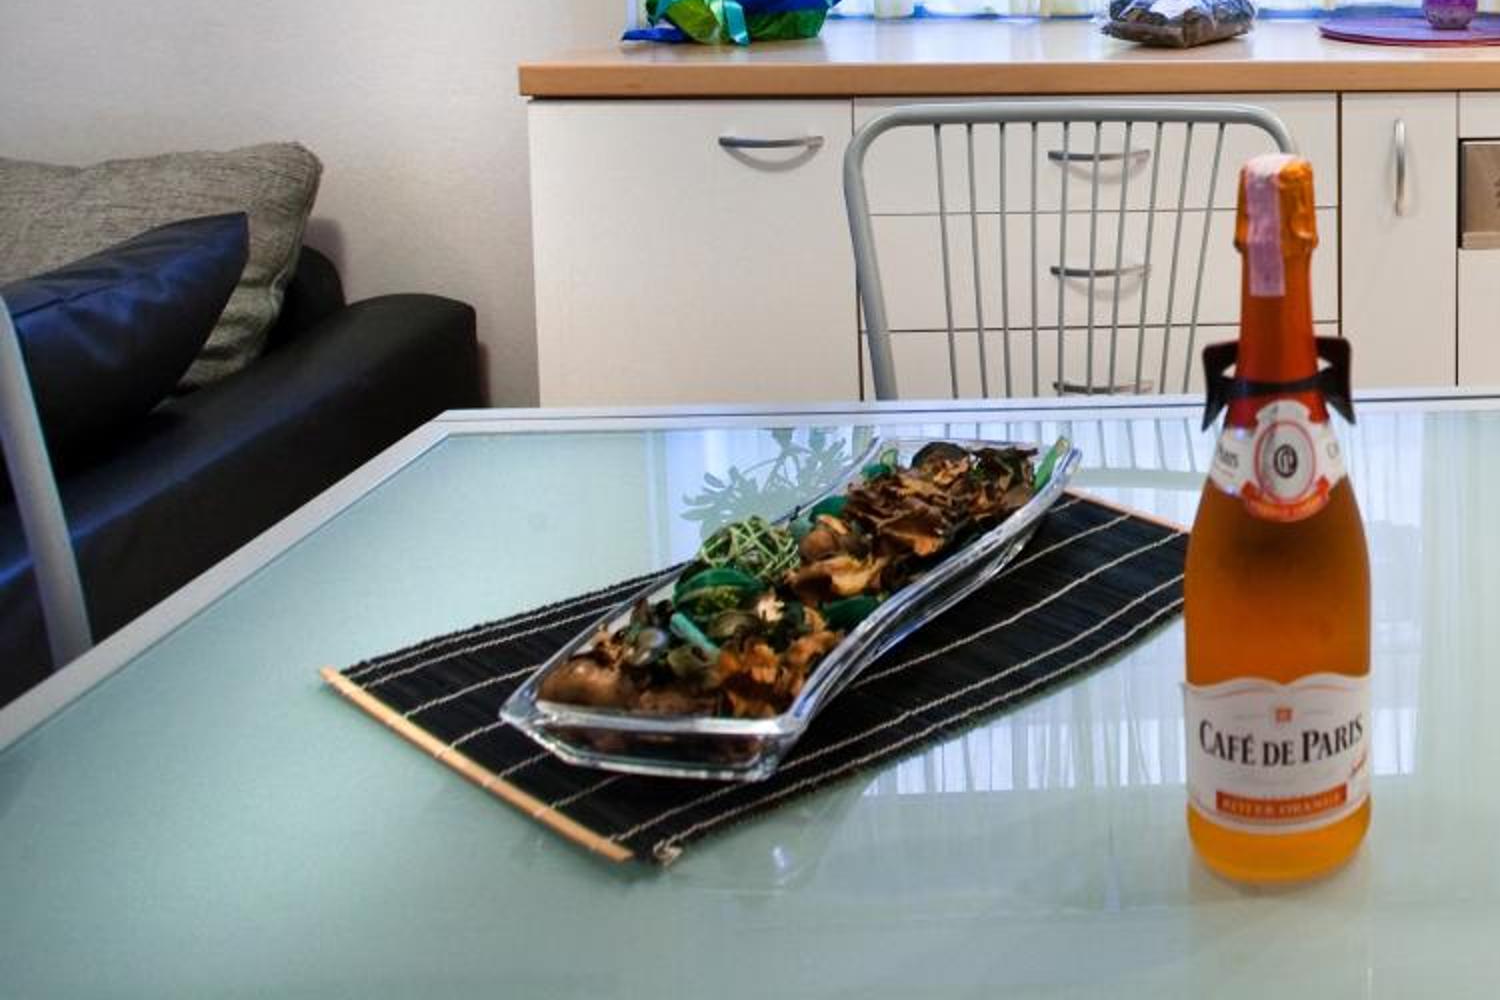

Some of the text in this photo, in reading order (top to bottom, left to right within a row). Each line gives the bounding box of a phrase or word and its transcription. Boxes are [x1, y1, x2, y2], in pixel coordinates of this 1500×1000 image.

[1199, 718, 1257, 767] CAFÉ
[1262, 740, 1297, 768] DE
[1301, 712, 1364, 764] PARIS
